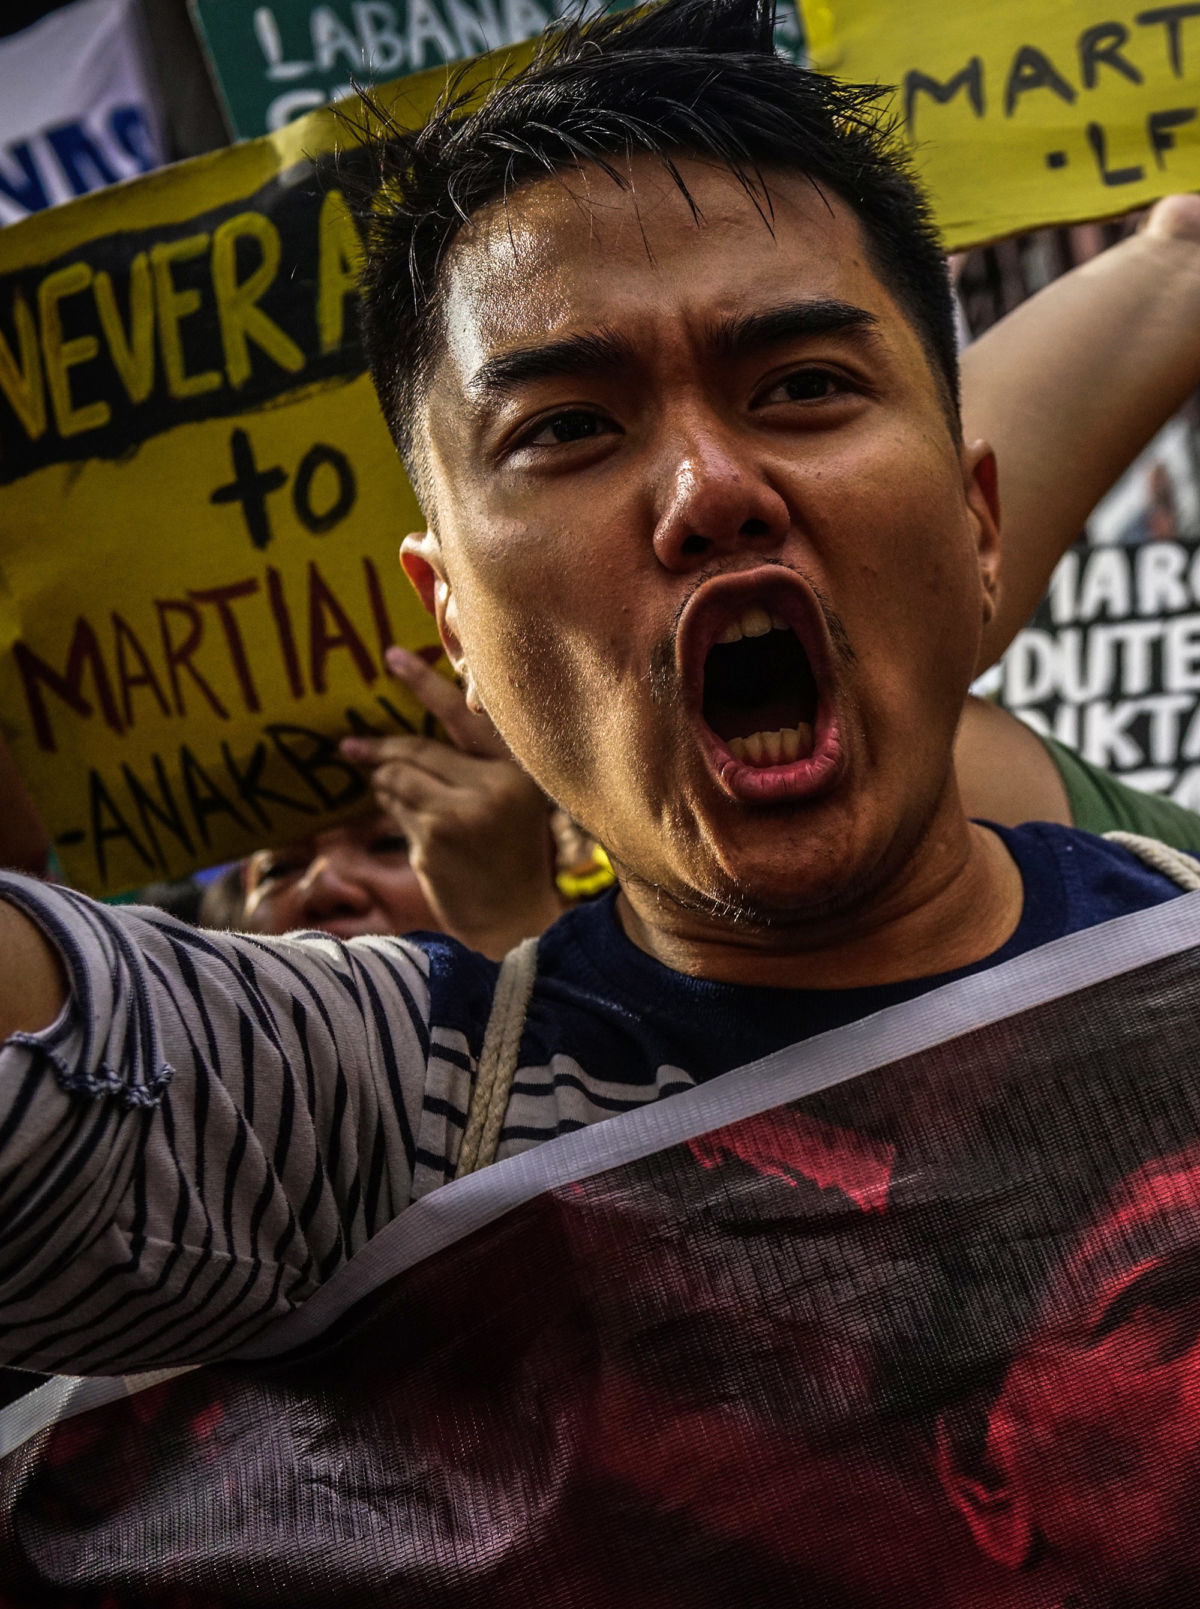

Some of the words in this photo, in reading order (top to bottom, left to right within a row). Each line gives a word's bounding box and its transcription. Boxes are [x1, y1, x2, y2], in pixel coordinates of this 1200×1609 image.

[0, 211, 306, 442] NEVER
[210, 427, 357, 551] to
[12, 556, 445, 754] MARTIAL
